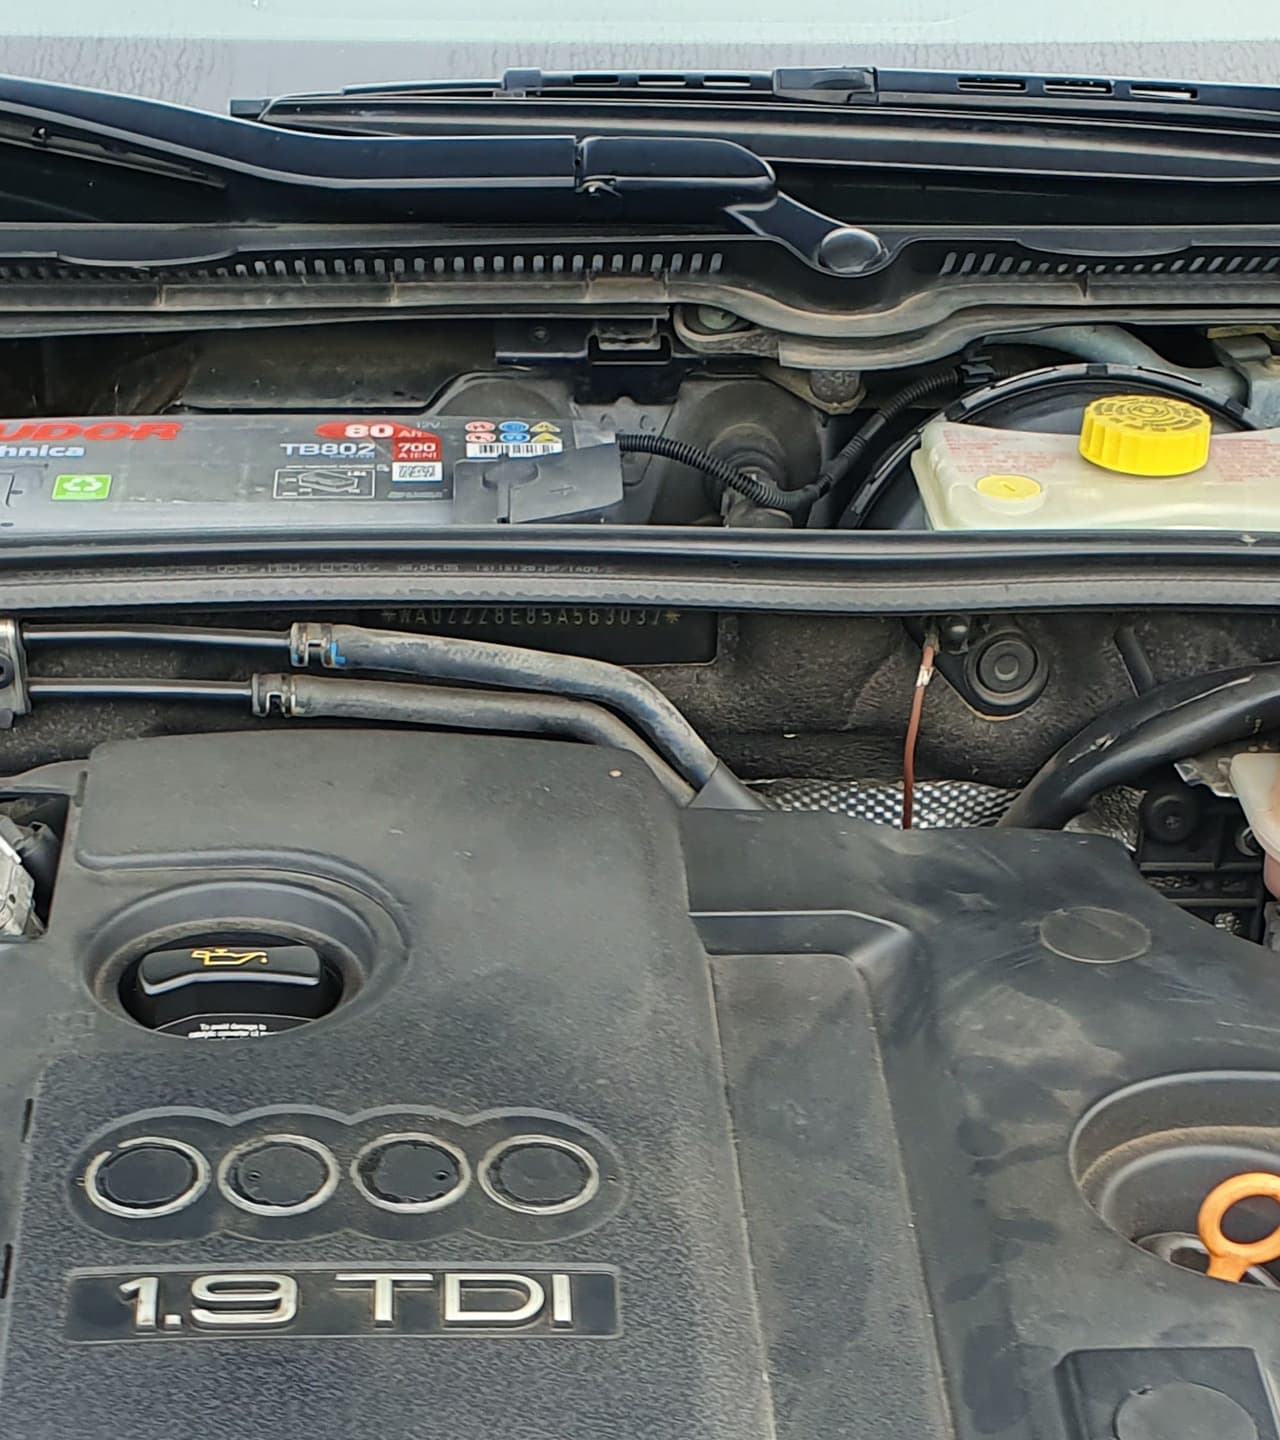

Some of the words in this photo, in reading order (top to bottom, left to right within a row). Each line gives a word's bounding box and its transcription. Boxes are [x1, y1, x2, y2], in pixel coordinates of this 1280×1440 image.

[344, 423, 395, 438] 80
[280, 442, 376, 457] TB802
[398, 442, 437, 452] 700
[120, 1273, 300, 1331] 1.9
[335, 1272, 574, 1329] TDI
